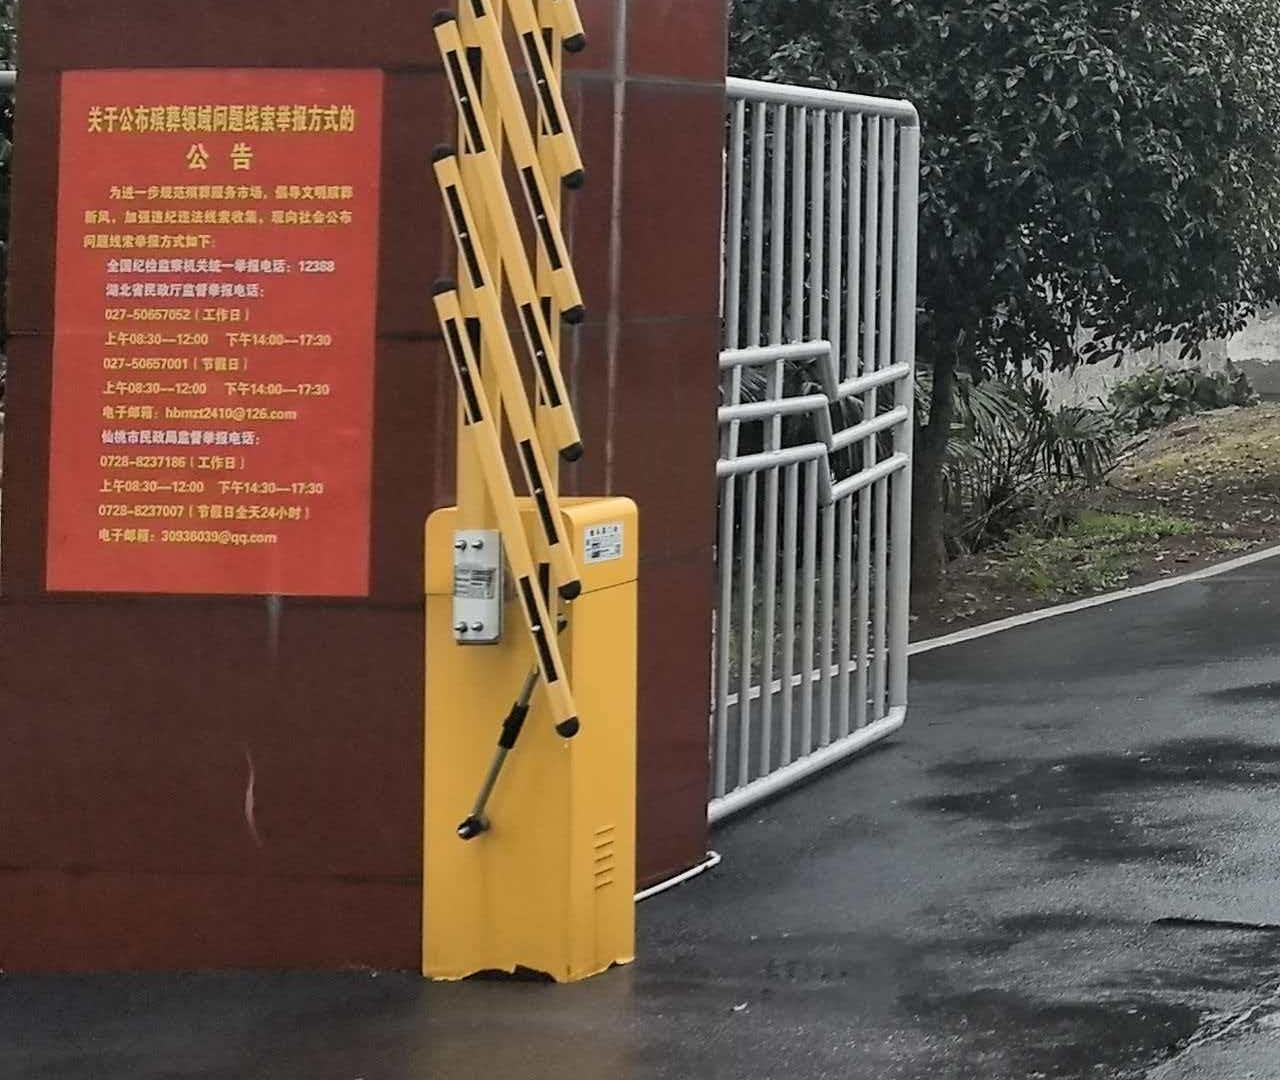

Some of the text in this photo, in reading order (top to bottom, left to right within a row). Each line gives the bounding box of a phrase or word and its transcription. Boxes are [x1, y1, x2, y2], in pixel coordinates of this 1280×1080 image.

[88, 105, 354, 132] 关于公布殡葬领域问题线索举报方式的
